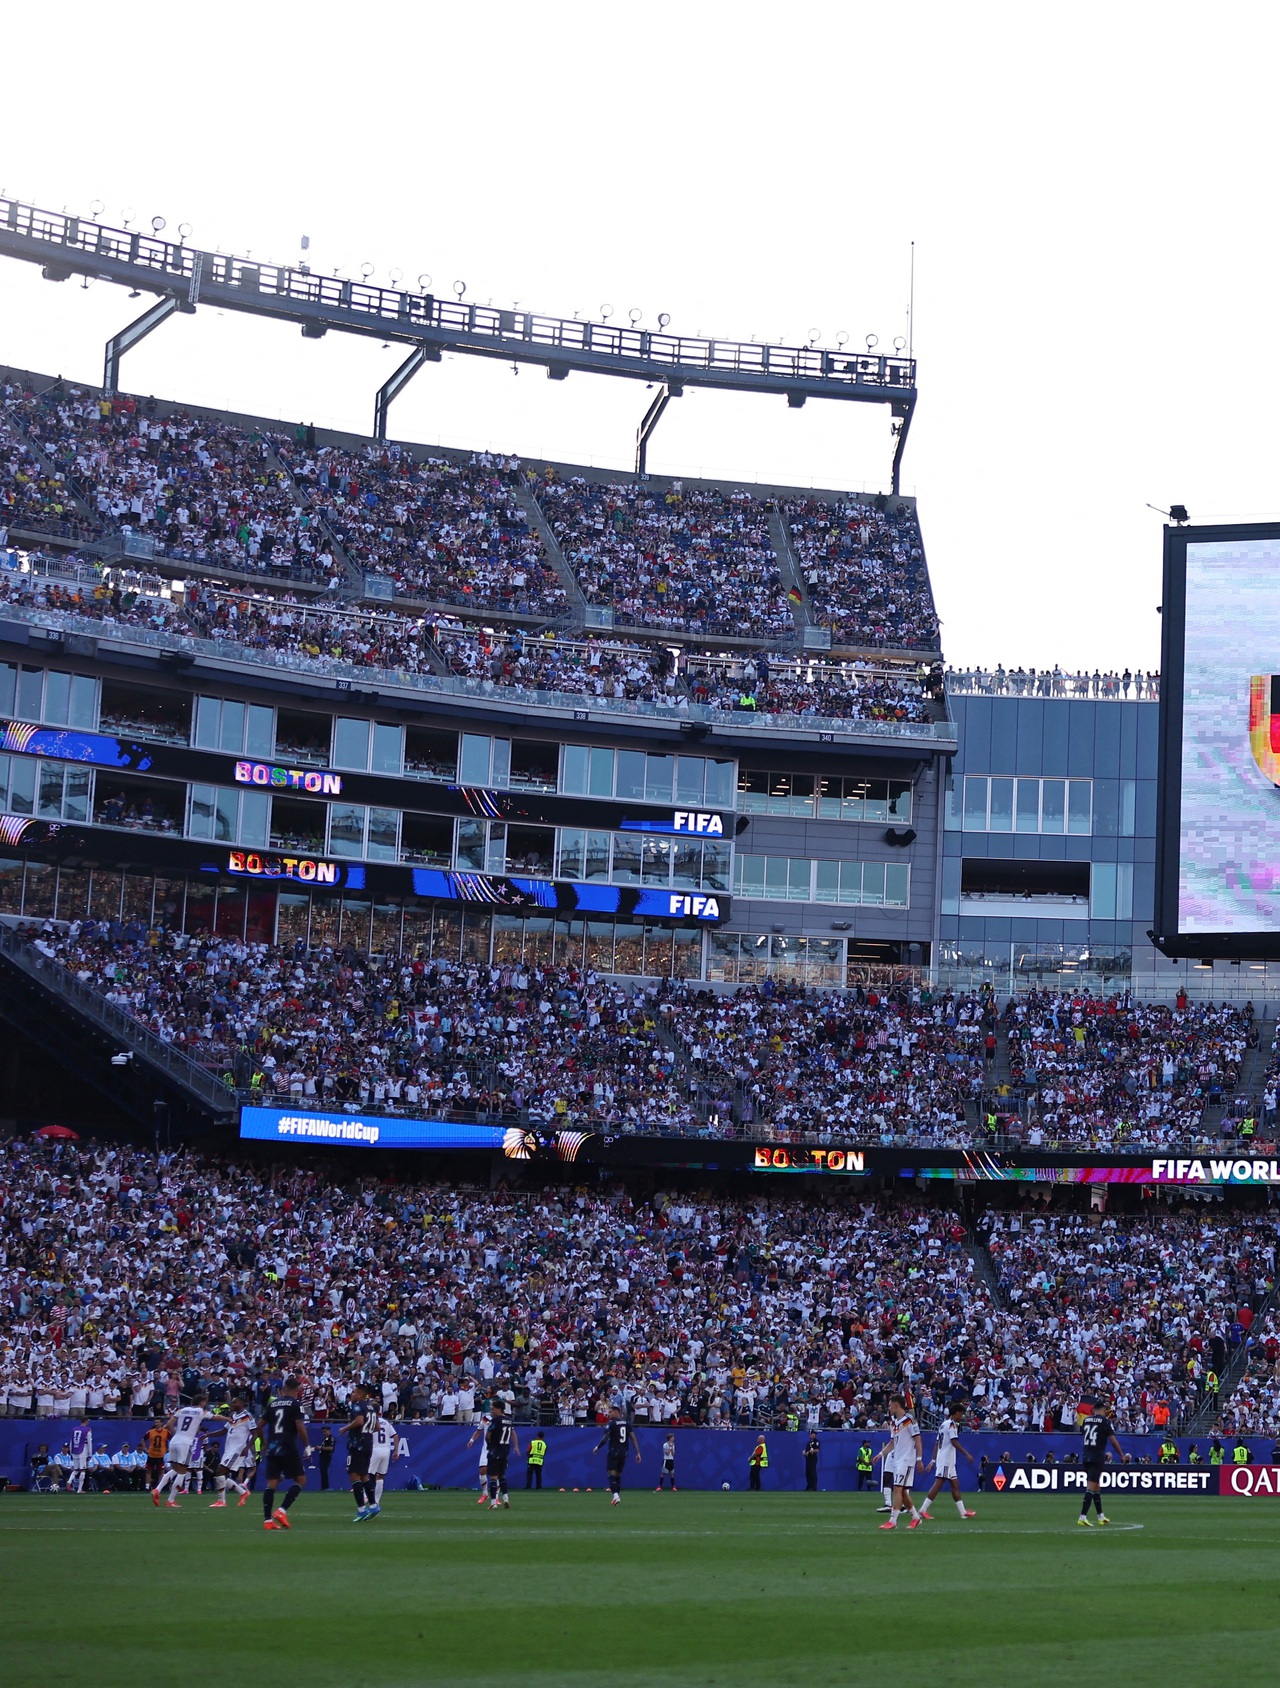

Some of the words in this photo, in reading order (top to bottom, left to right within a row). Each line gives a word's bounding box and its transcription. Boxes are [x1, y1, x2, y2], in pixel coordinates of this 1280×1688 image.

[338, 681, 349, 690] 337
[821, 733, 832, 742] 340
[234, 761, 342, 795] BOSTON
[673, 811, 723, 834] FIFA
[228, 851, 336, 883] BOSTON
[669, 895, 719, 917] FIFA
[278, 1116, 379, 1144] #FIFAWorldCup
[1152, 1159, 1207, 1180] FIFA
[180, 1416, 193, 1432] 8
[274, 1408, 285, 1434] 2
[361, 1411, 377, 1434] 20
[377, 1427, 386, 1444] 6
[499, 1426, 512, 1445] 11
[619, 1426, 627, 1444] 9
[1083, 1424, 1098, 1446] 24
[1009, 1468, 1058, 1490] ADI
[1063, 1471, 1211, 1489] PRDICTSTREET
